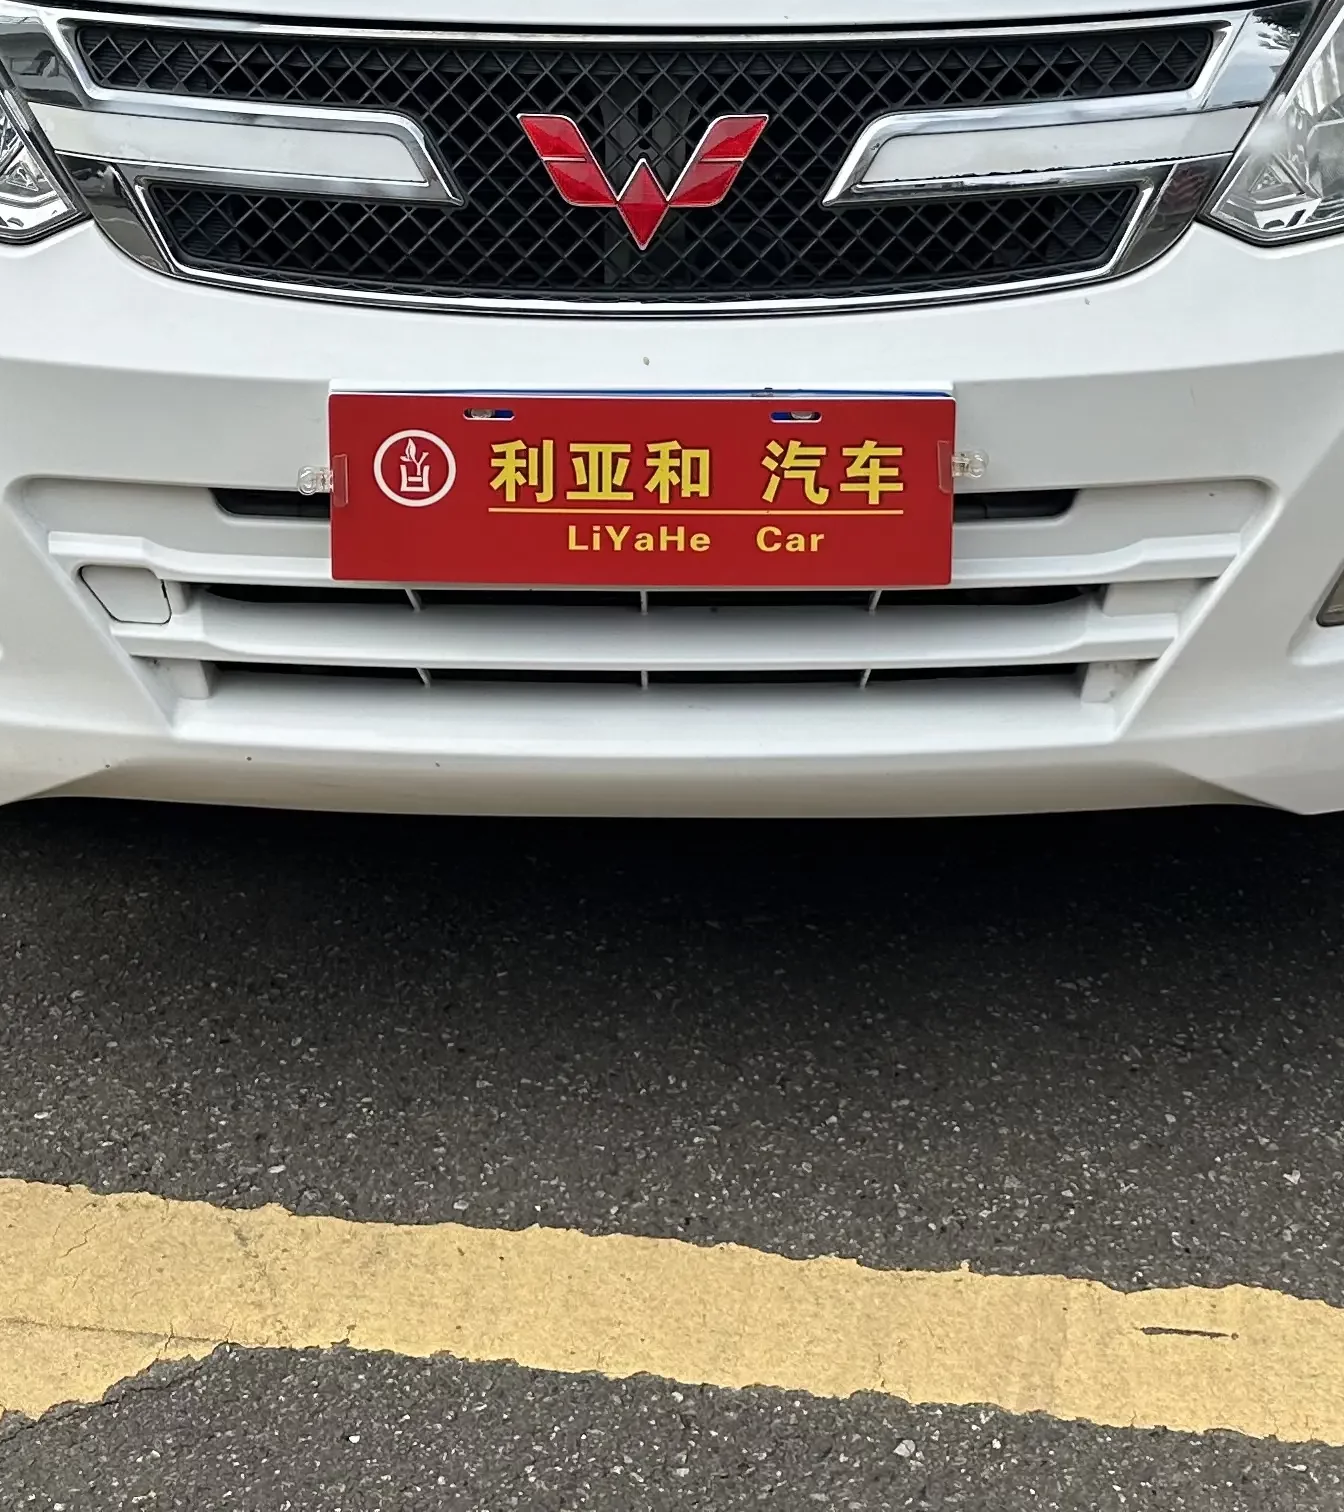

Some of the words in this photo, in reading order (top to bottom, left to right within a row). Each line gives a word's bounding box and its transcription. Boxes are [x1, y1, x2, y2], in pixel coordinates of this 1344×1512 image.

[489, 439, 711, 504] 利亚和
[760, 439, 905, 506] 汽车
[567, 525, 712, 552] LiYaHe
[755, 526, 825, 553] Car
